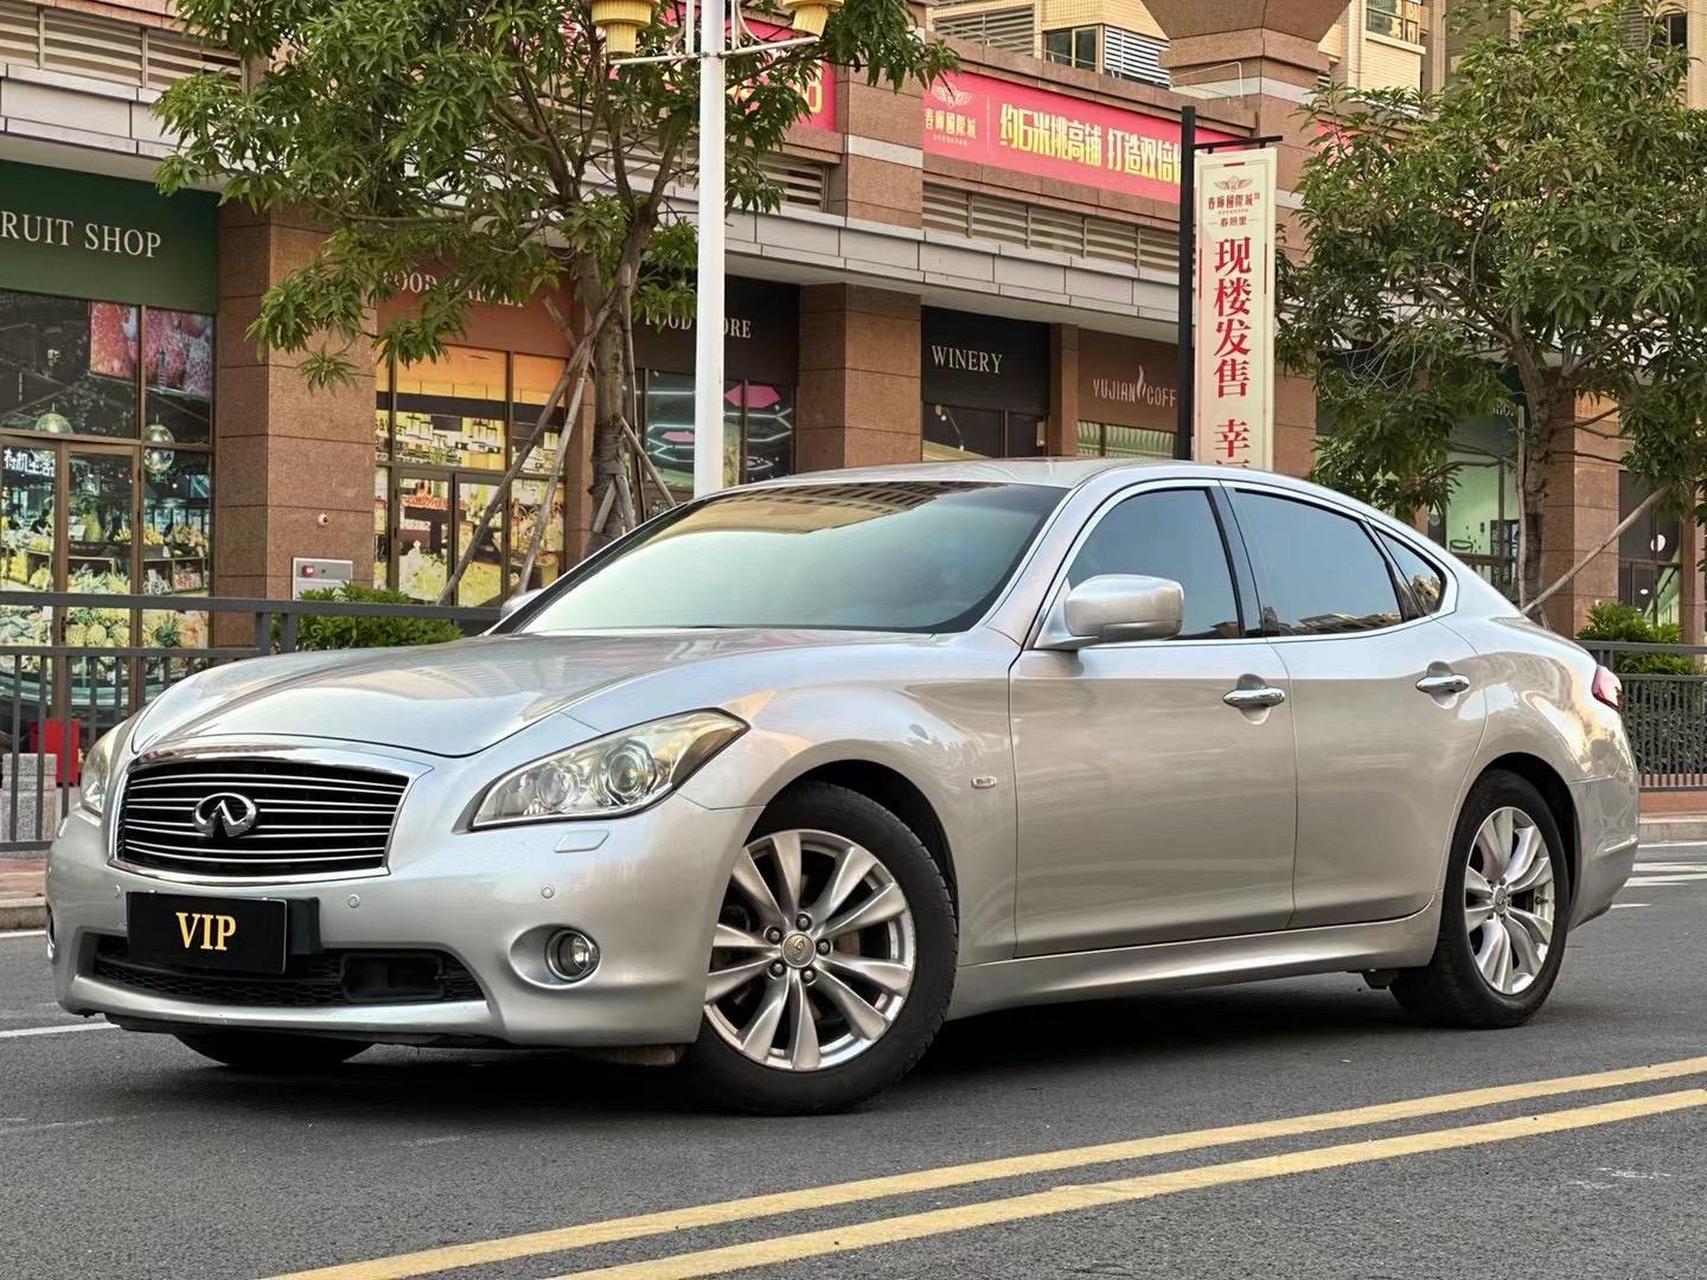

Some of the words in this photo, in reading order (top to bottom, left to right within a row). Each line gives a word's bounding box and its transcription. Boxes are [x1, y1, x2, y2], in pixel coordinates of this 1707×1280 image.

[1000, 103, 1102, 168] 约6米挑高铺
[0, 210, 73, 246] RUIT
[84, 223, 161, 258] SHOP
[383, 270, 437, 293] OOD
[645, 305, 693, 331] OD
[1214, 236, 1252, 399] 现楼发售
[931, 345, 1002, 374] WINERY
[1093, 378, 1136, 403] YUJIAN
[1146, 385, 1177, 408] COFF
[1214, 418, 1251, 469] 幸
[175, 911, 237, 951] VIP
